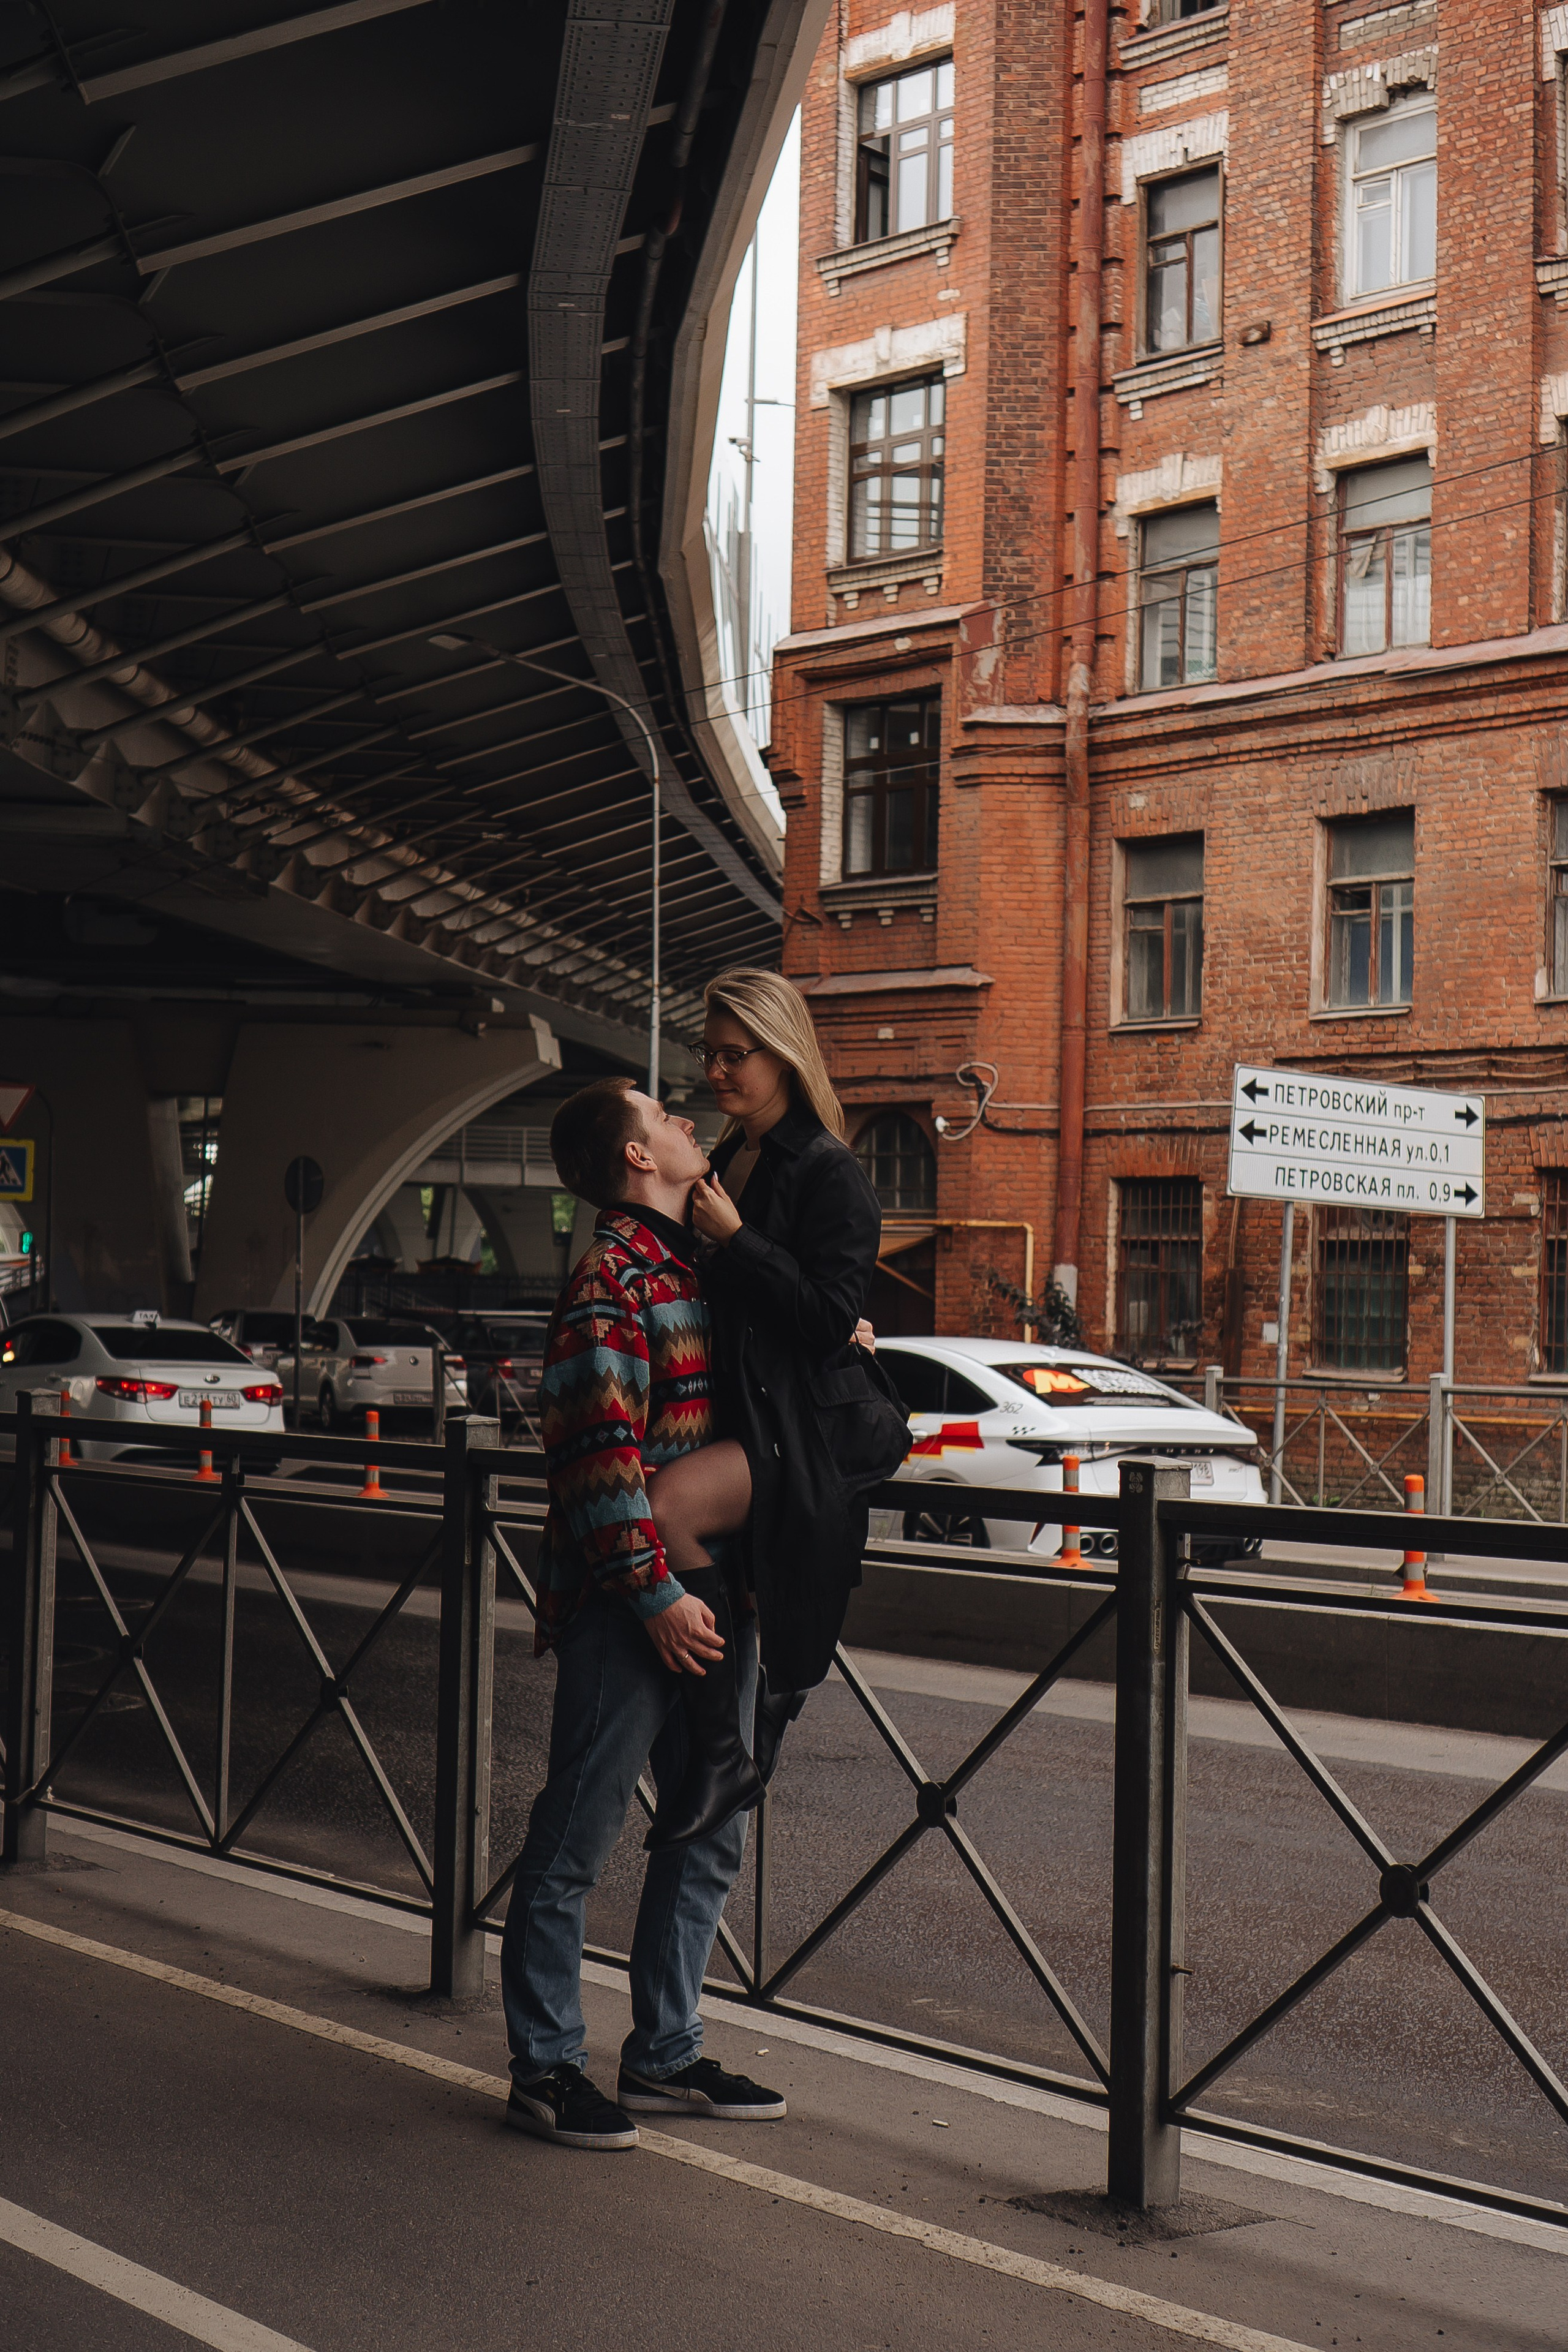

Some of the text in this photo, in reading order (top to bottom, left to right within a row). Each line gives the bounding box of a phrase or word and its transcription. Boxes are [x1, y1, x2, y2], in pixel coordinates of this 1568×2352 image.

[1275, 1083, 1425, 1123] ПЕТРОВСКИЙ пр-т
[1269, 1125, 1401, 1158] РЕМЕСЛЕННАЯ
[1275, 1167, 1450, 1204] ПЕТРОВСКАЯ пл. 0,9
[1000, 1401, 1023, 1415] 362
